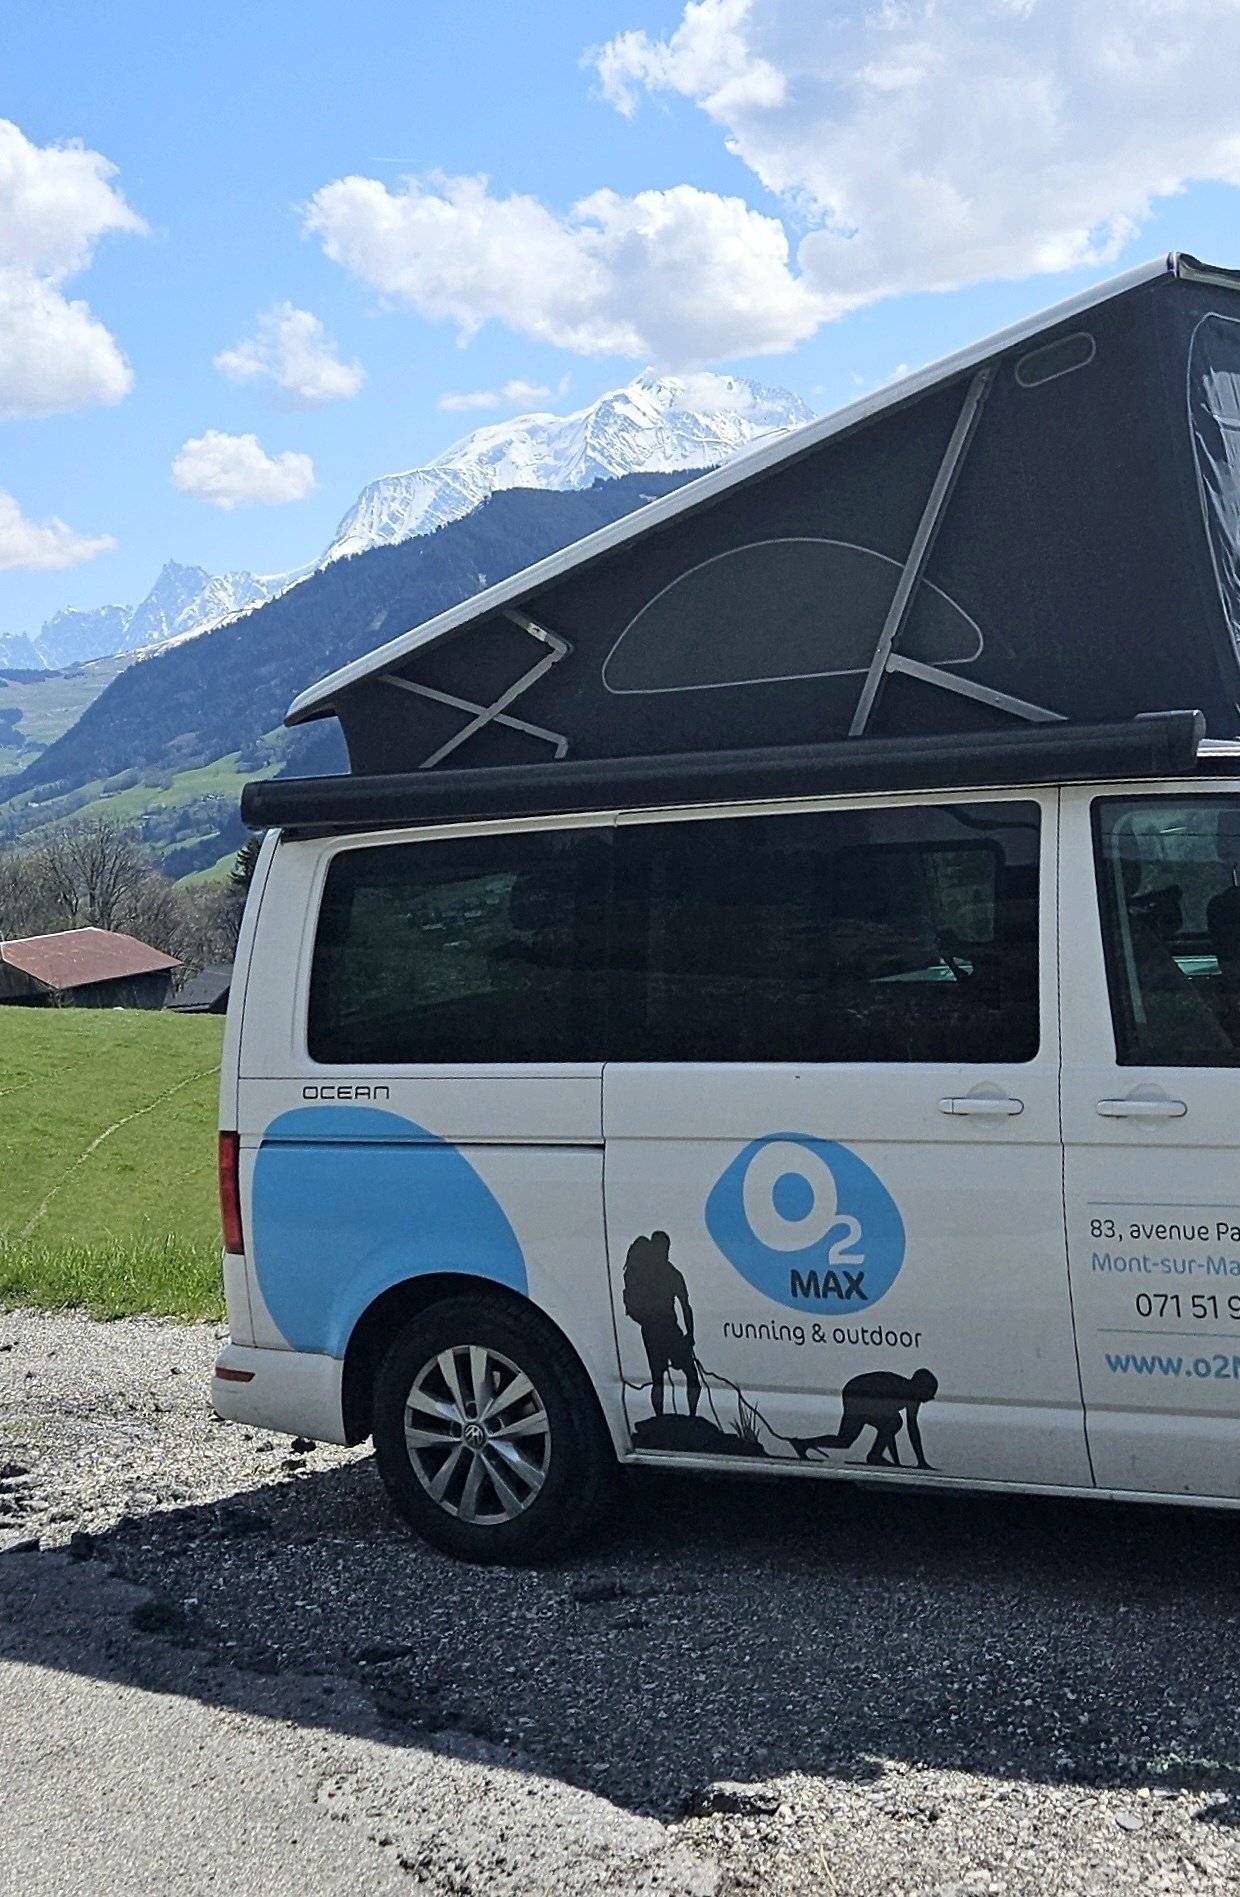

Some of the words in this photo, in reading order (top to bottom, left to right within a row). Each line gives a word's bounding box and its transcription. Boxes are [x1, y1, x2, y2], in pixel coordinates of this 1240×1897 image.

[302, 1085, 390, 1100] OCEAN
[1090, 1219, 1123, 1242] 83,
[1130, 1222, 1209, 1241] avenue
[790, 1269, 869, 1300] MAX
[1136, 1293, 1181, 1318] 071
[1191, 1295, 1219, 1319] 51
[723, 1320, 806, 1345] running
[811, 1323, 827, 1343] &
[833, 1326, 922, 1348] outdoor
